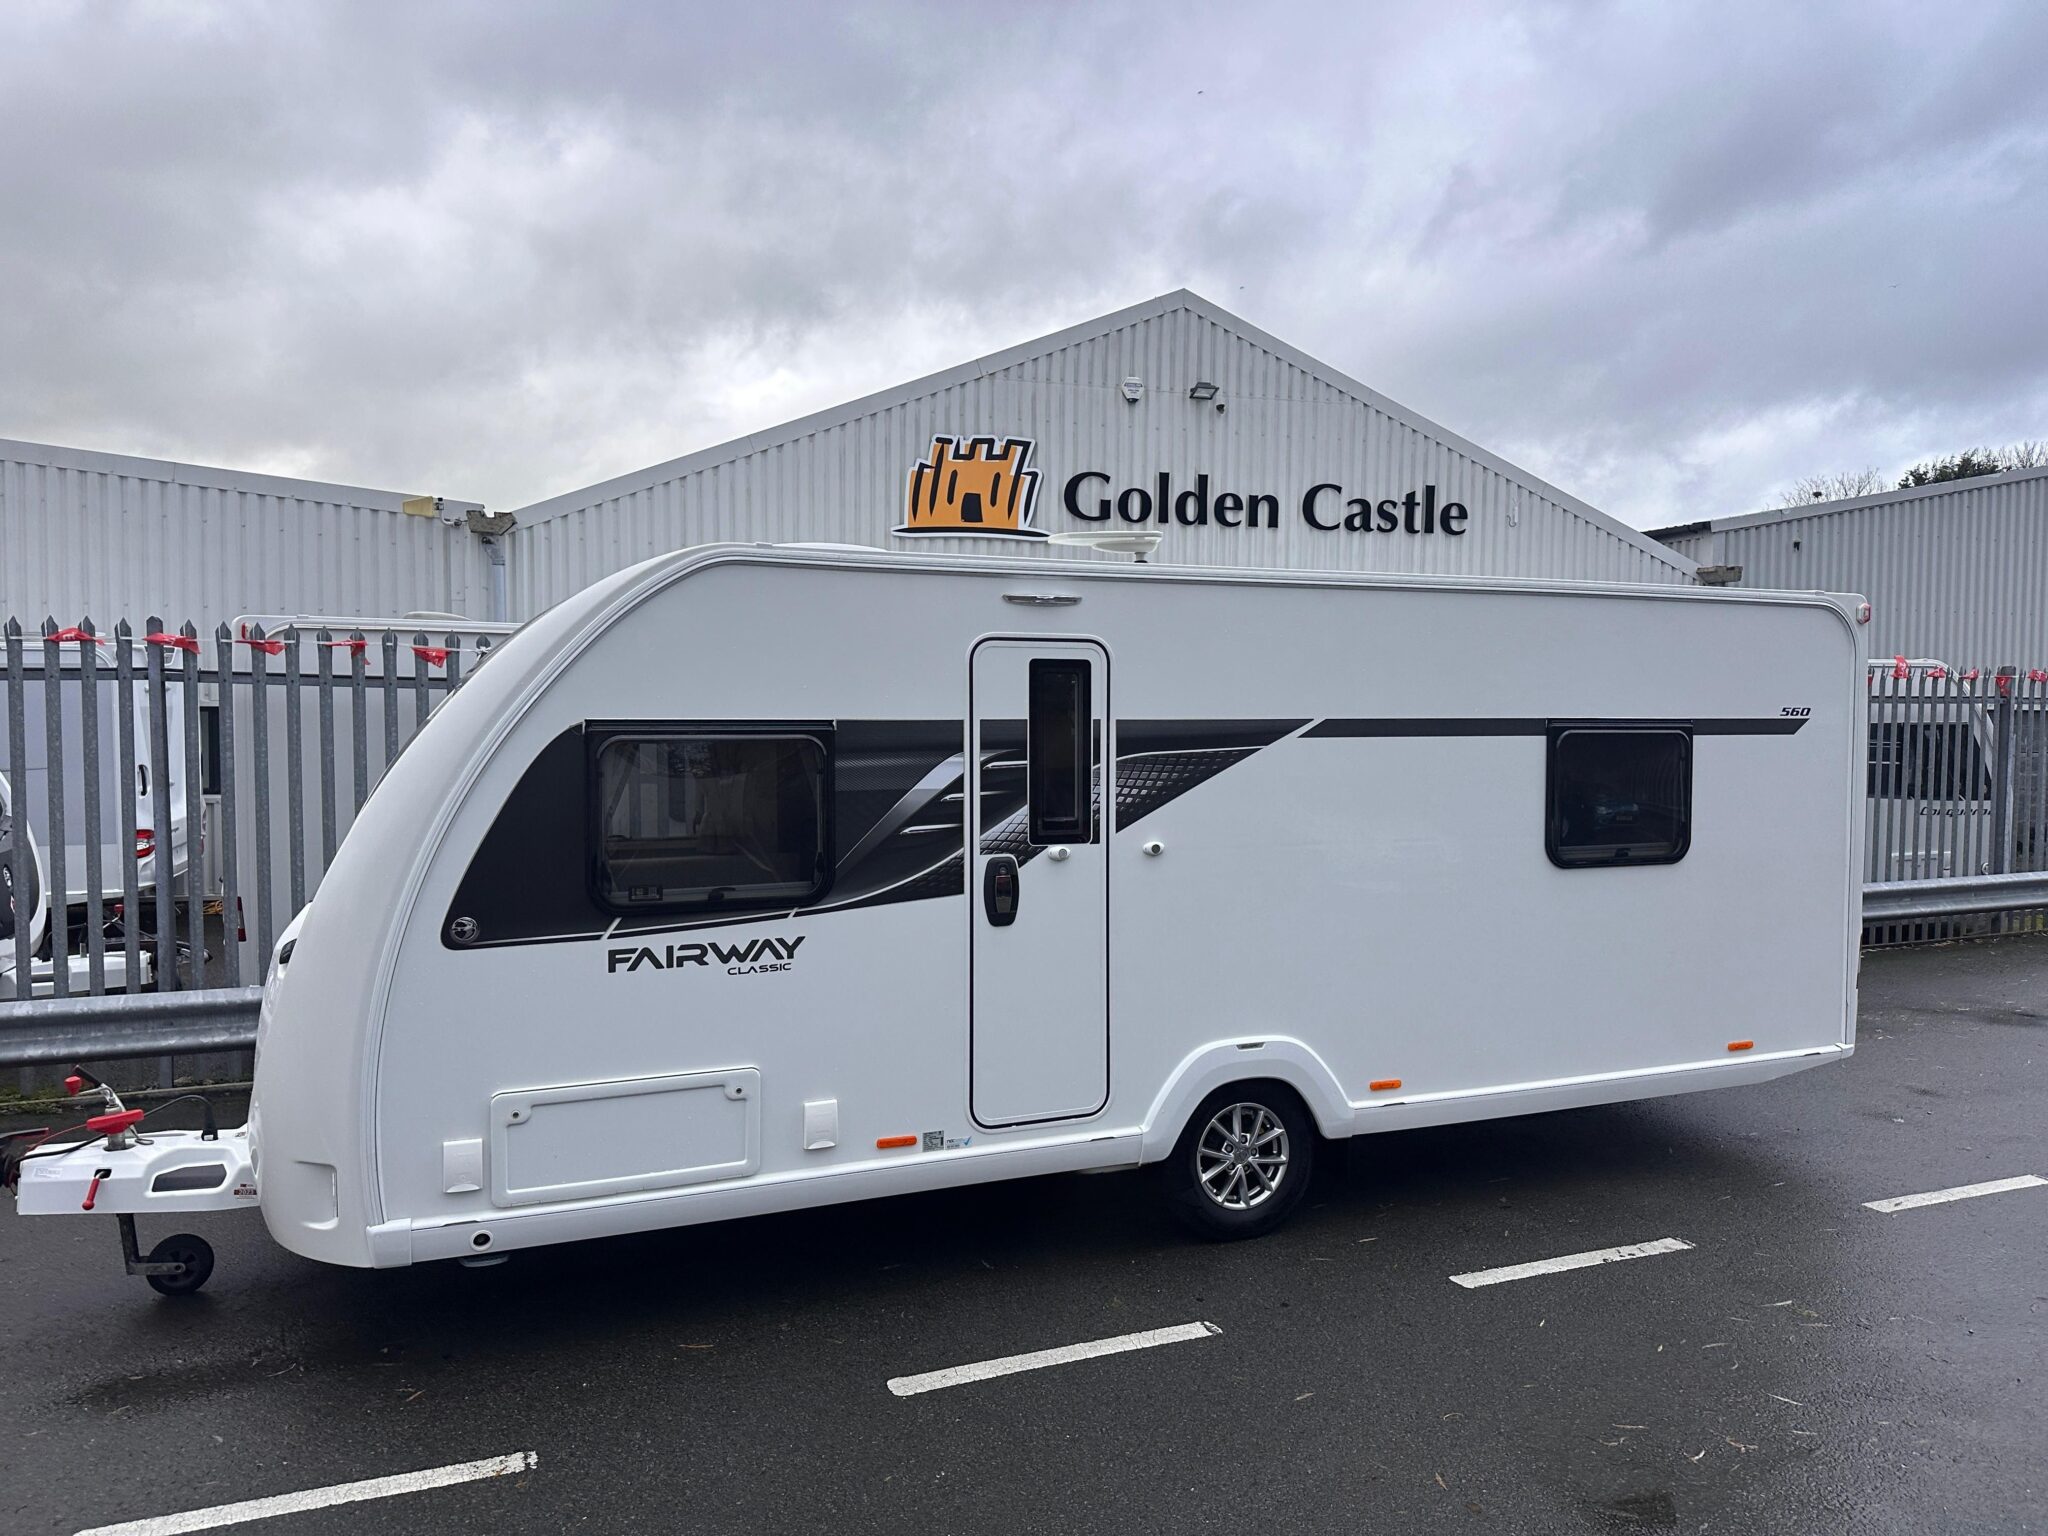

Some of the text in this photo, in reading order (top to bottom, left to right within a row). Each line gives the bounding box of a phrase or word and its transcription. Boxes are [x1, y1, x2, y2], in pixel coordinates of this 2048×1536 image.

[1063, 471, 1469, 536] Golden Castle
[1779, 706, 1812, 717] 560
[607, 936, 806, 973] FAIRWAY
[727, 962, 792, 976] CLASSIC
